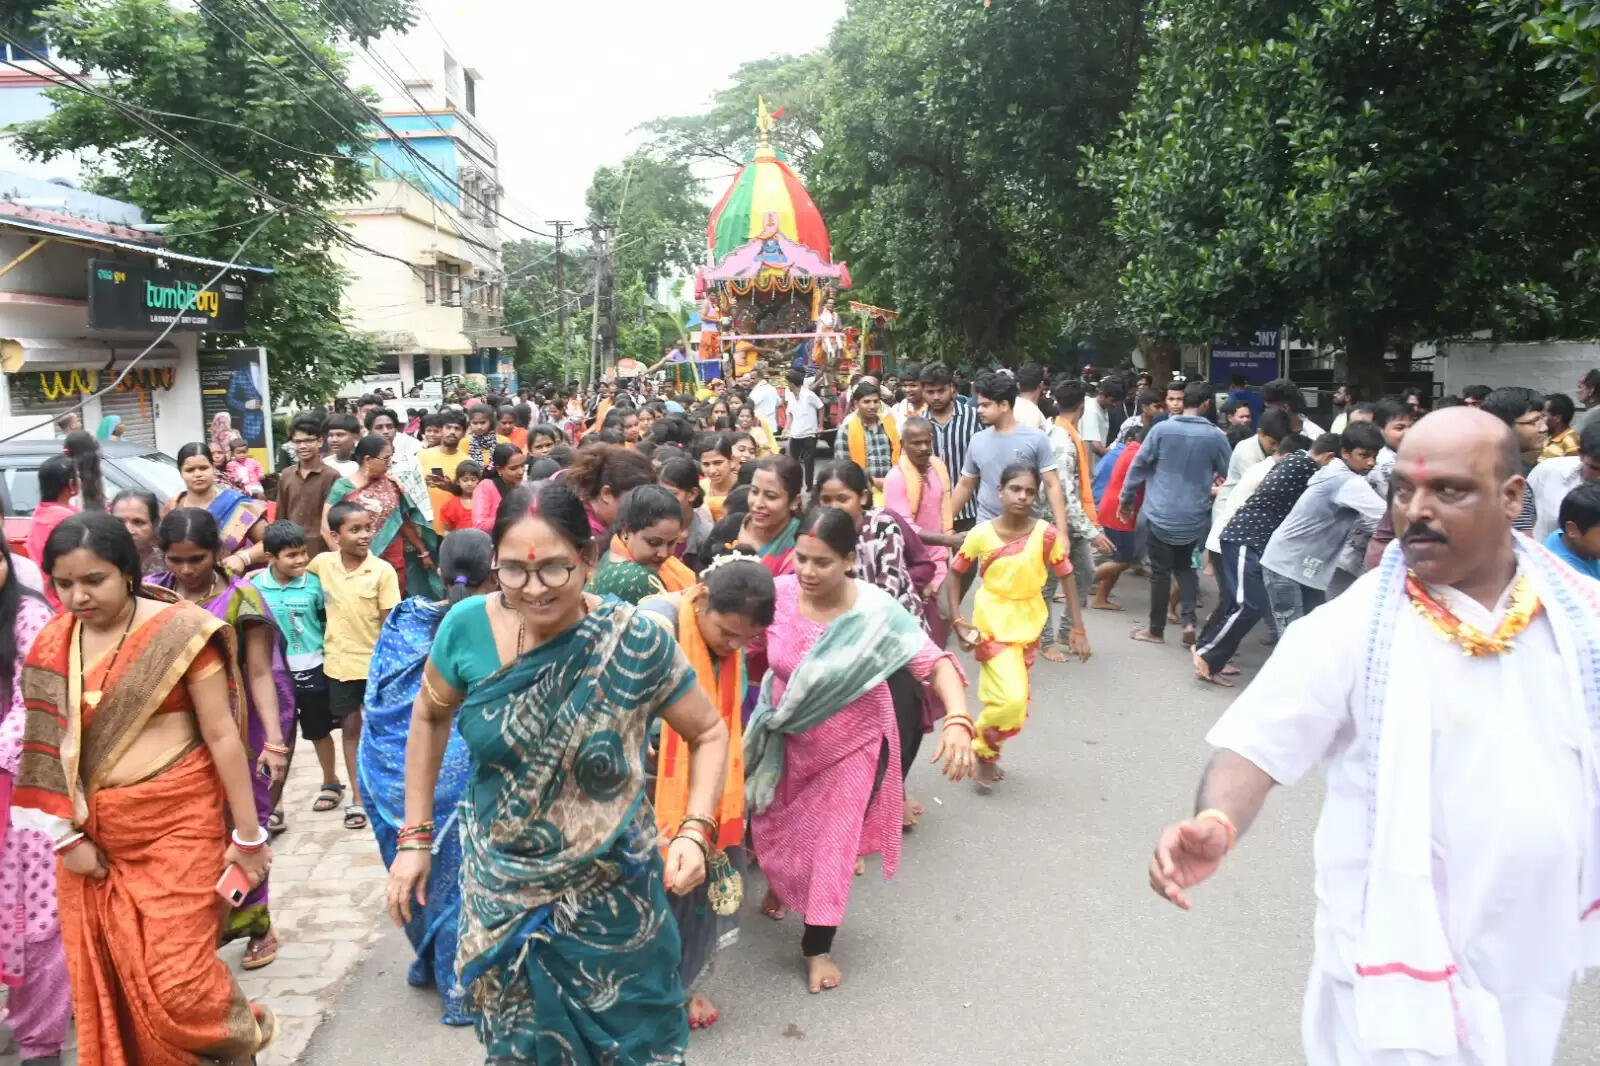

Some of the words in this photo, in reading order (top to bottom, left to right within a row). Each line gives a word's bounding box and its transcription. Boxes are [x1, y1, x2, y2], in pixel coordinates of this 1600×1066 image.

[150, 315, 176, 324] LAUNDRY
[181, 316, 191, 324] DRY
[192, 317, 208, 325] CLEAN
[1212, 350, 1247, 358] GOVERNMENT
